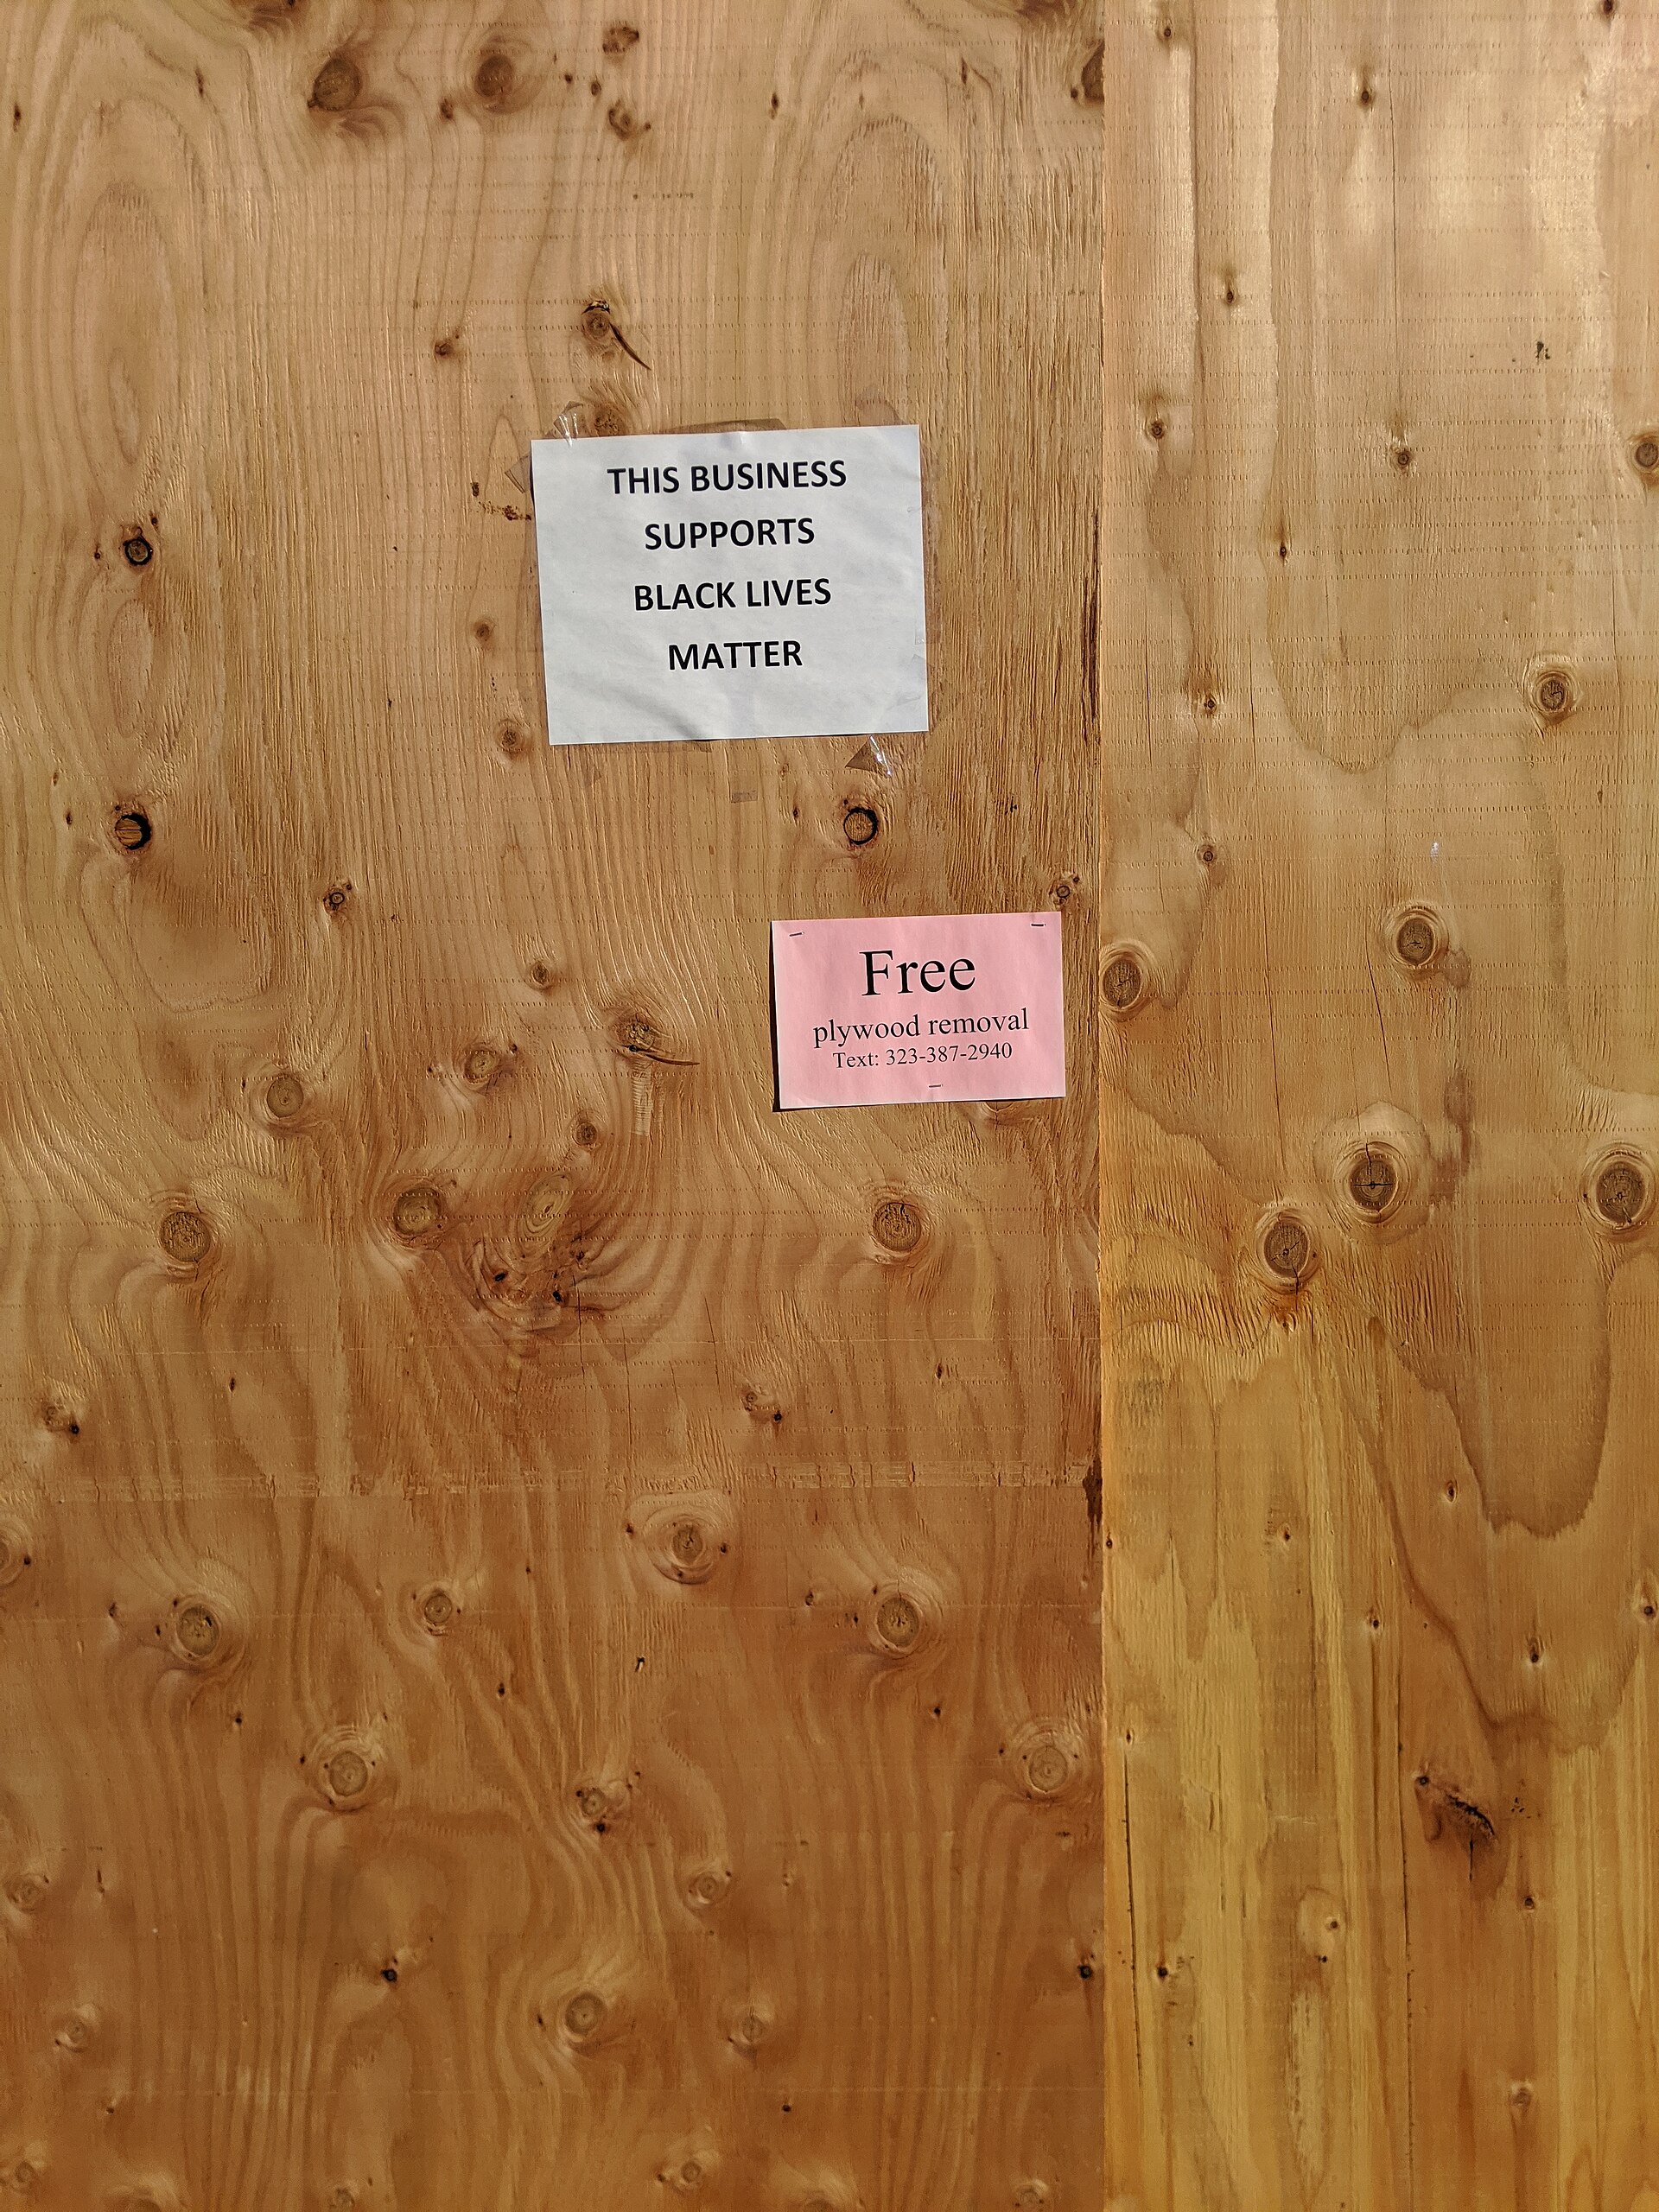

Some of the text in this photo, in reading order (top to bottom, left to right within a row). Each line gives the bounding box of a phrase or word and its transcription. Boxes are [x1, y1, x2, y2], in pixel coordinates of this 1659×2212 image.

[607, 460, 847, 495] THIS BUSINESS
[645, 518, 815, 550] SUPPORTS
[634, 578, 831, 611] BLACK LIVES
[668, 640, 803, 671] MATTER
[859, 950, 976, 996] Free
[813, 1007, 1029, 1049] plywood removal
[832, 1041, 1013, 1069] Text: 323-387-2940
